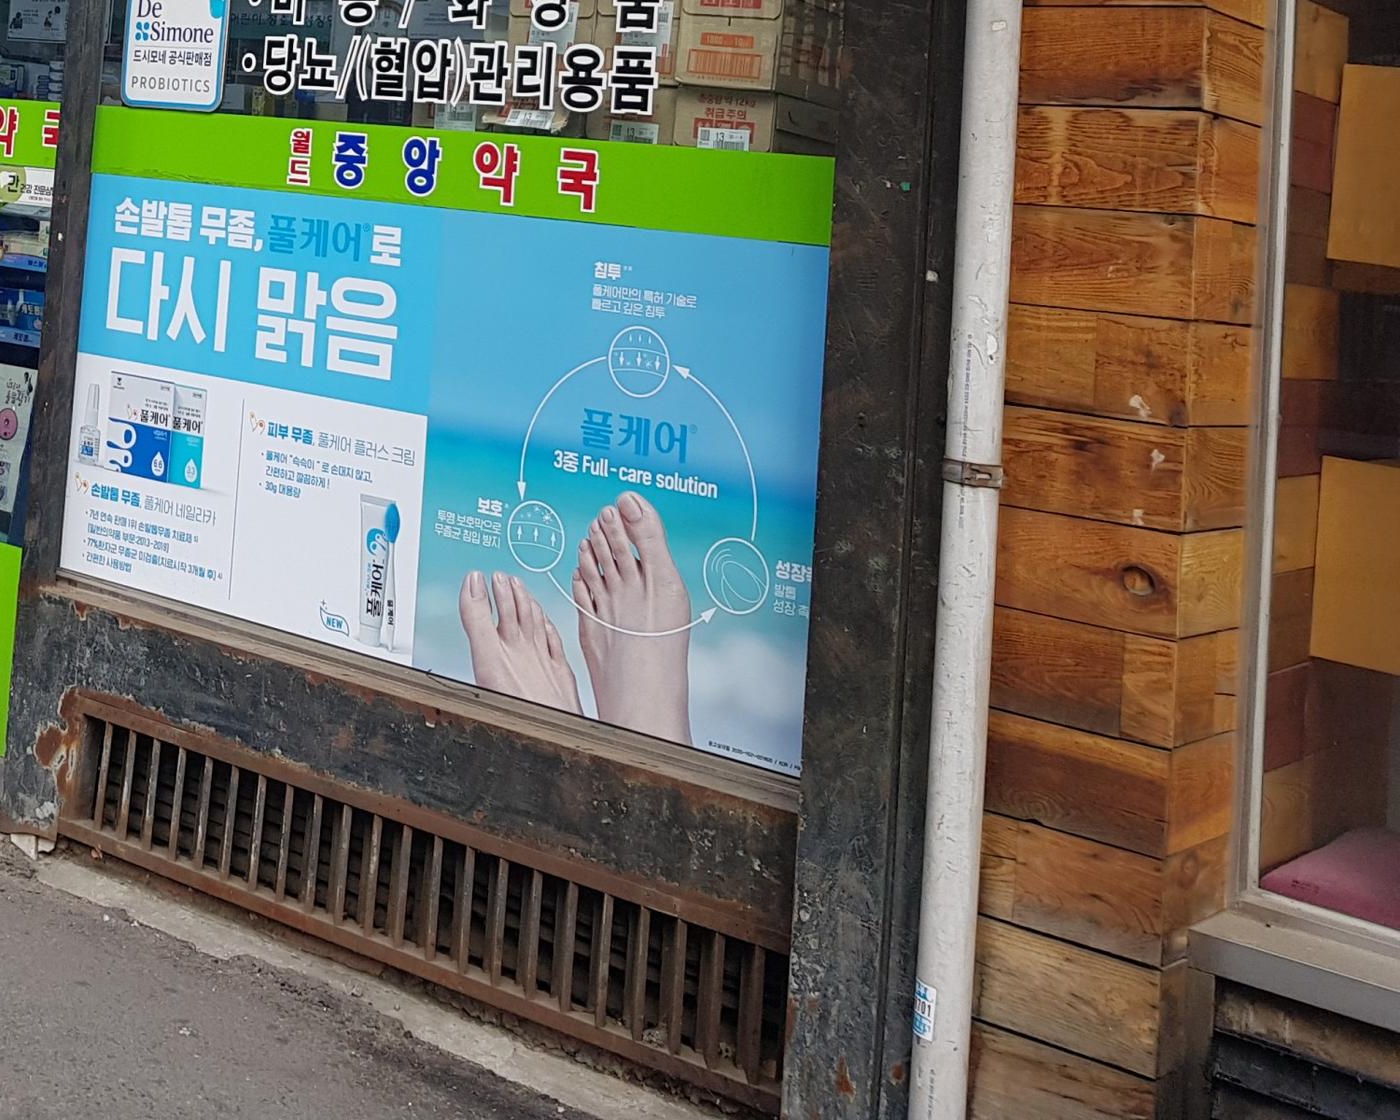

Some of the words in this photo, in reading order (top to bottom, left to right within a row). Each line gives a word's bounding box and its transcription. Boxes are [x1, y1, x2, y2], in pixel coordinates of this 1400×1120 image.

[150, 20, 214, 44] Simone
[133, 50, 166, 65] 드시모네
[168, 51, 213, 68] 공식판매점
[131, 75, 210, 93] PROBIOTICS
[261, 32, 661, 116] 당뇨/(혈압)관리용품
[286, 127, 314, 187] 월드
[332, 130, 600, 213] 중앙약국
[7, 174, 20, 194] 간
[115, 196, 194, 241] 손발톱
[199, 205, 264, 252] 무좀,
[594, 261, 622, 281] 침투
[623, 302, 644, 317] 깊은
[645, 304, 666, 319] 침투
[666, 293, 698, 309] 기술로
[106, 246, 232, 354] 다시
[254, 266, 399, 381] 맑음
[267, 421, 289, 440] 피부
[291, 426, 315, 446] 무좀,
[318, 431, 352, 454] 풀케어
[354, 438, 389, 461] 플러스
[391, 446, 416, 467] 크림
[265, 465, 296, 481] 간편하고
[331, 464, 354, 479] 손대지
[553, 450, 580, 473] 3중
[655, 472, 718, 499] solution
[264, 480, 278, 494] 30g
[90, 482, 119, 502] 손발톱
[144, 494, 174, 517] 풀케어
[175, 502, 216, 527] 네일라카
[477, 497, 502, 518] 보호
[89, 509, 100, 521] 7년
[100, 511, 113, 524] 연속
[437, 509, 456, 524] 투명
[456, 514, 502, 535] 보호막으로
[435, 522, 461, 540] 무좀균
[463, 529, 481, 545] 침입
[482, 534, 501, 550] 방지
[86, 551, 106, 566] 간편한
[772, 599, 796, 617] 성장
[326, 614, 344, 630] NEW
